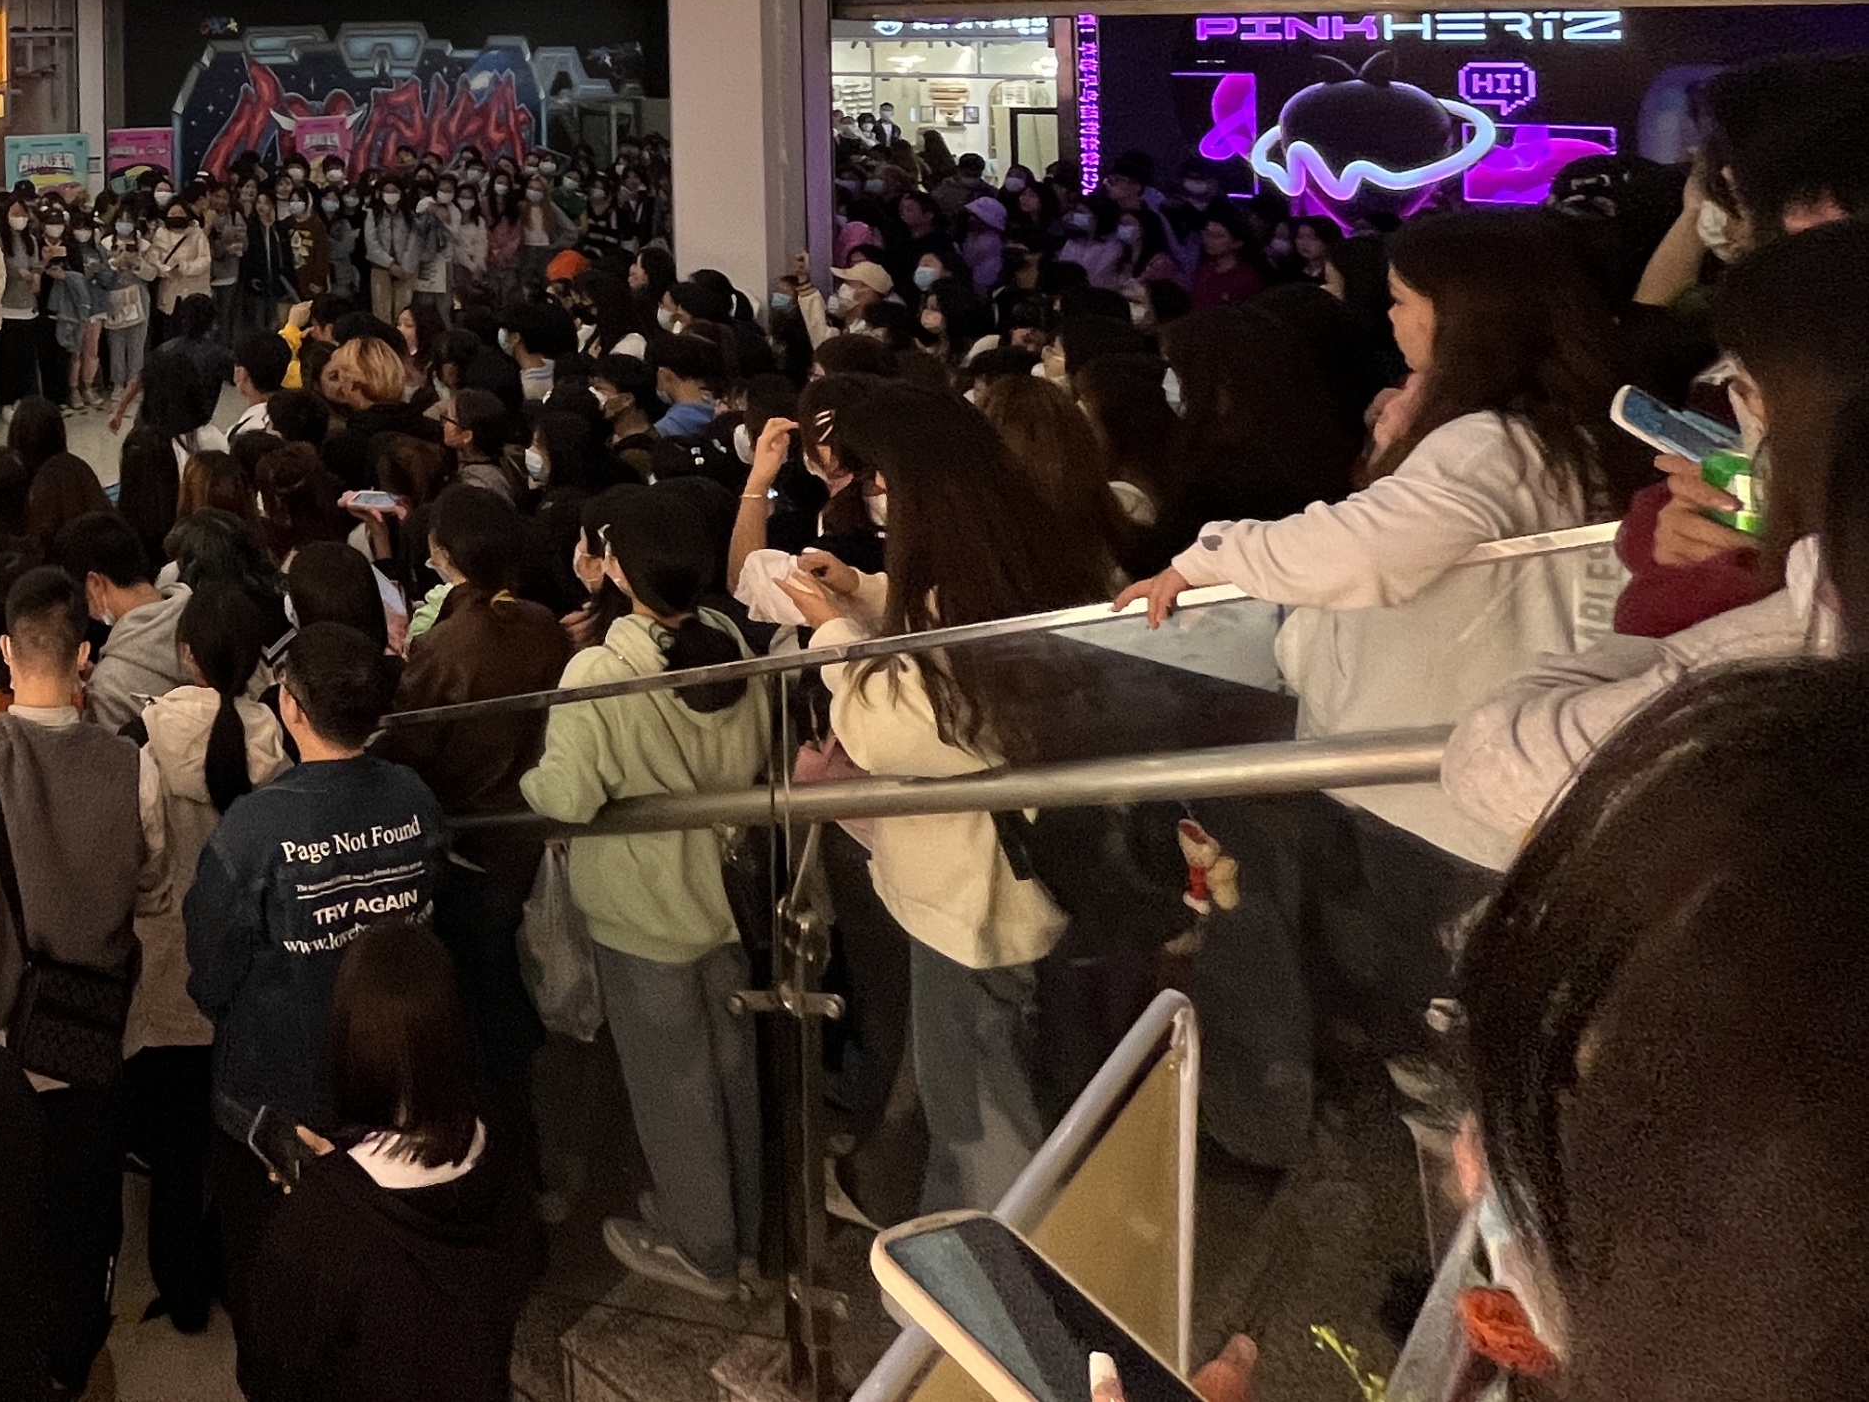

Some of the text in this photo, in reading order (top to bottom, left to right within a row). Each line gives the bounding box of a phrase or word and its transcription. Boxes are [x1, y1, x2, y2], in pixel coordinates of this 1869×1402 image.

[1471, 72, 1522, 95] HI!
[281, 813, 422, 864] Page Not Found
[312, 889, 418, 926] TRY AGAIN
